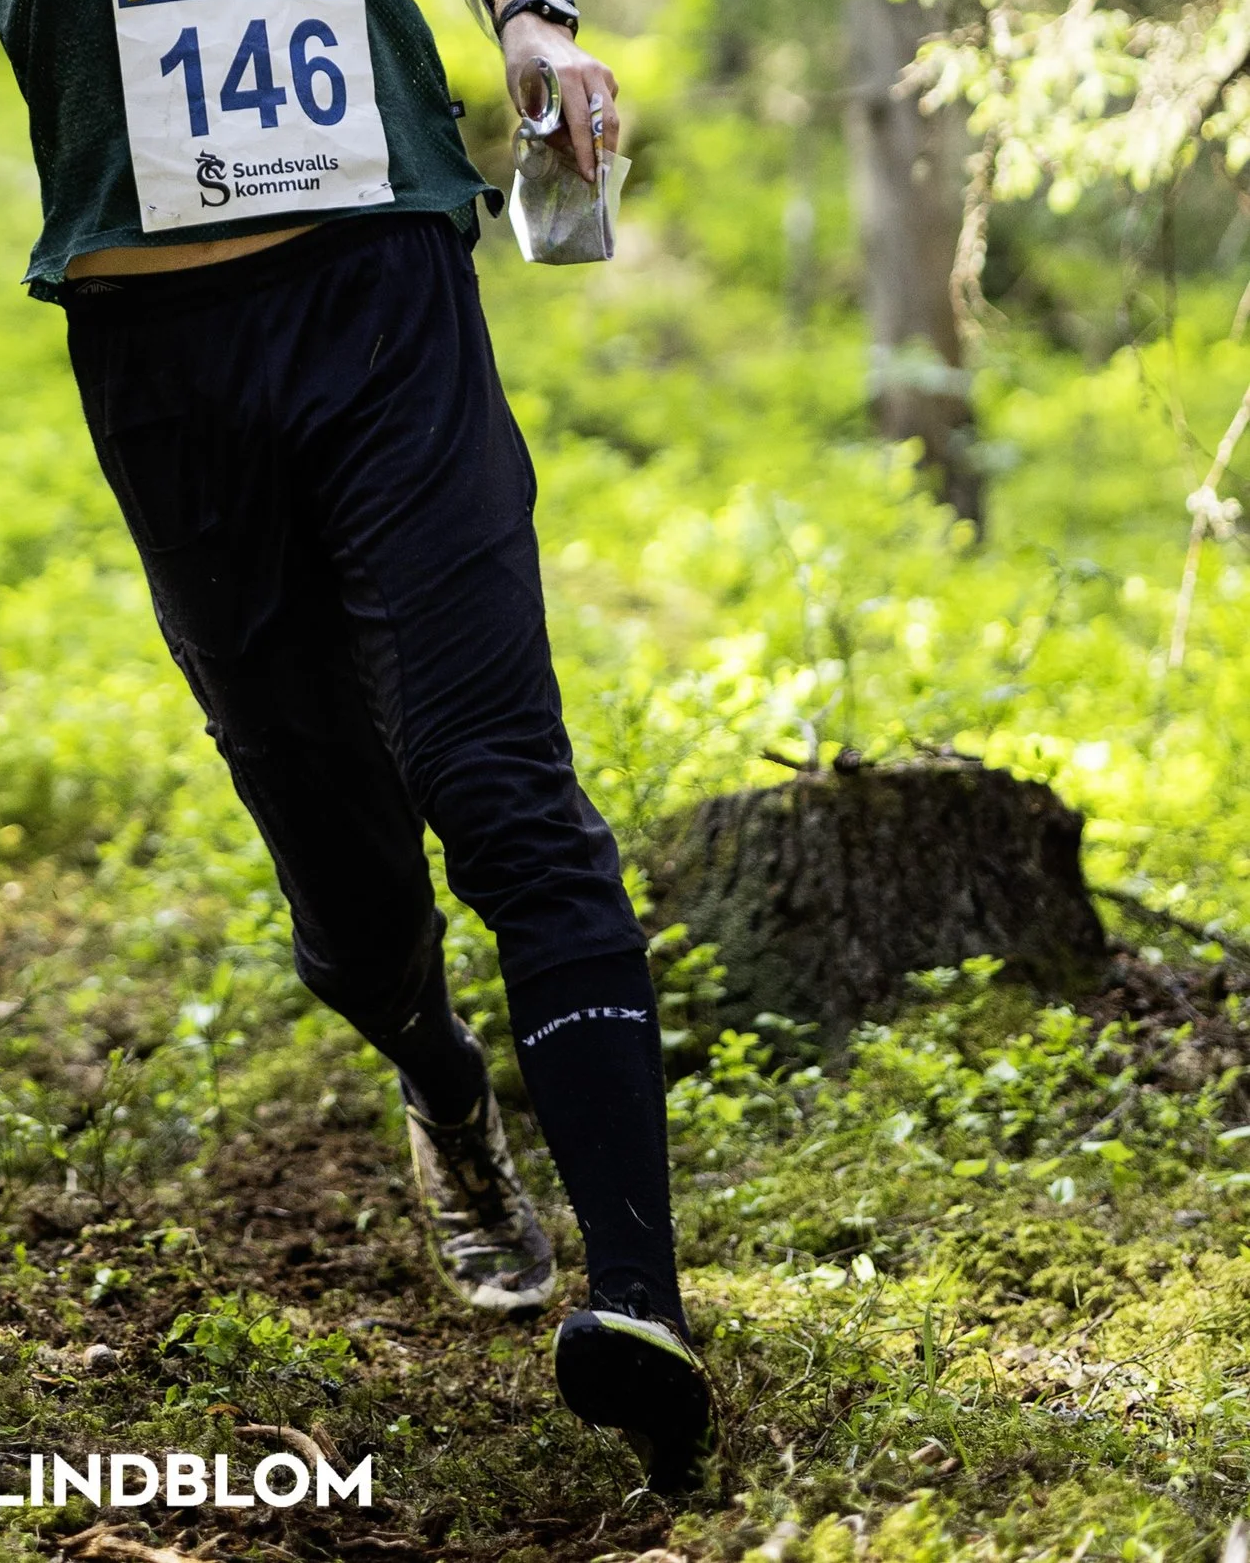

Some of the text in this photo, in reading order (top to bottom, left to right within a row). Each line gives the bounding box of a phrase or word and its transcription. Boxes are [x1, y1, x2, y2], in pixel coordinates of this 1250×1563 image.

[160, 18, 348, 138] 146
[232, 154, 340, 179] Sundsvalls
[234, 177, 321, 198] kommun
